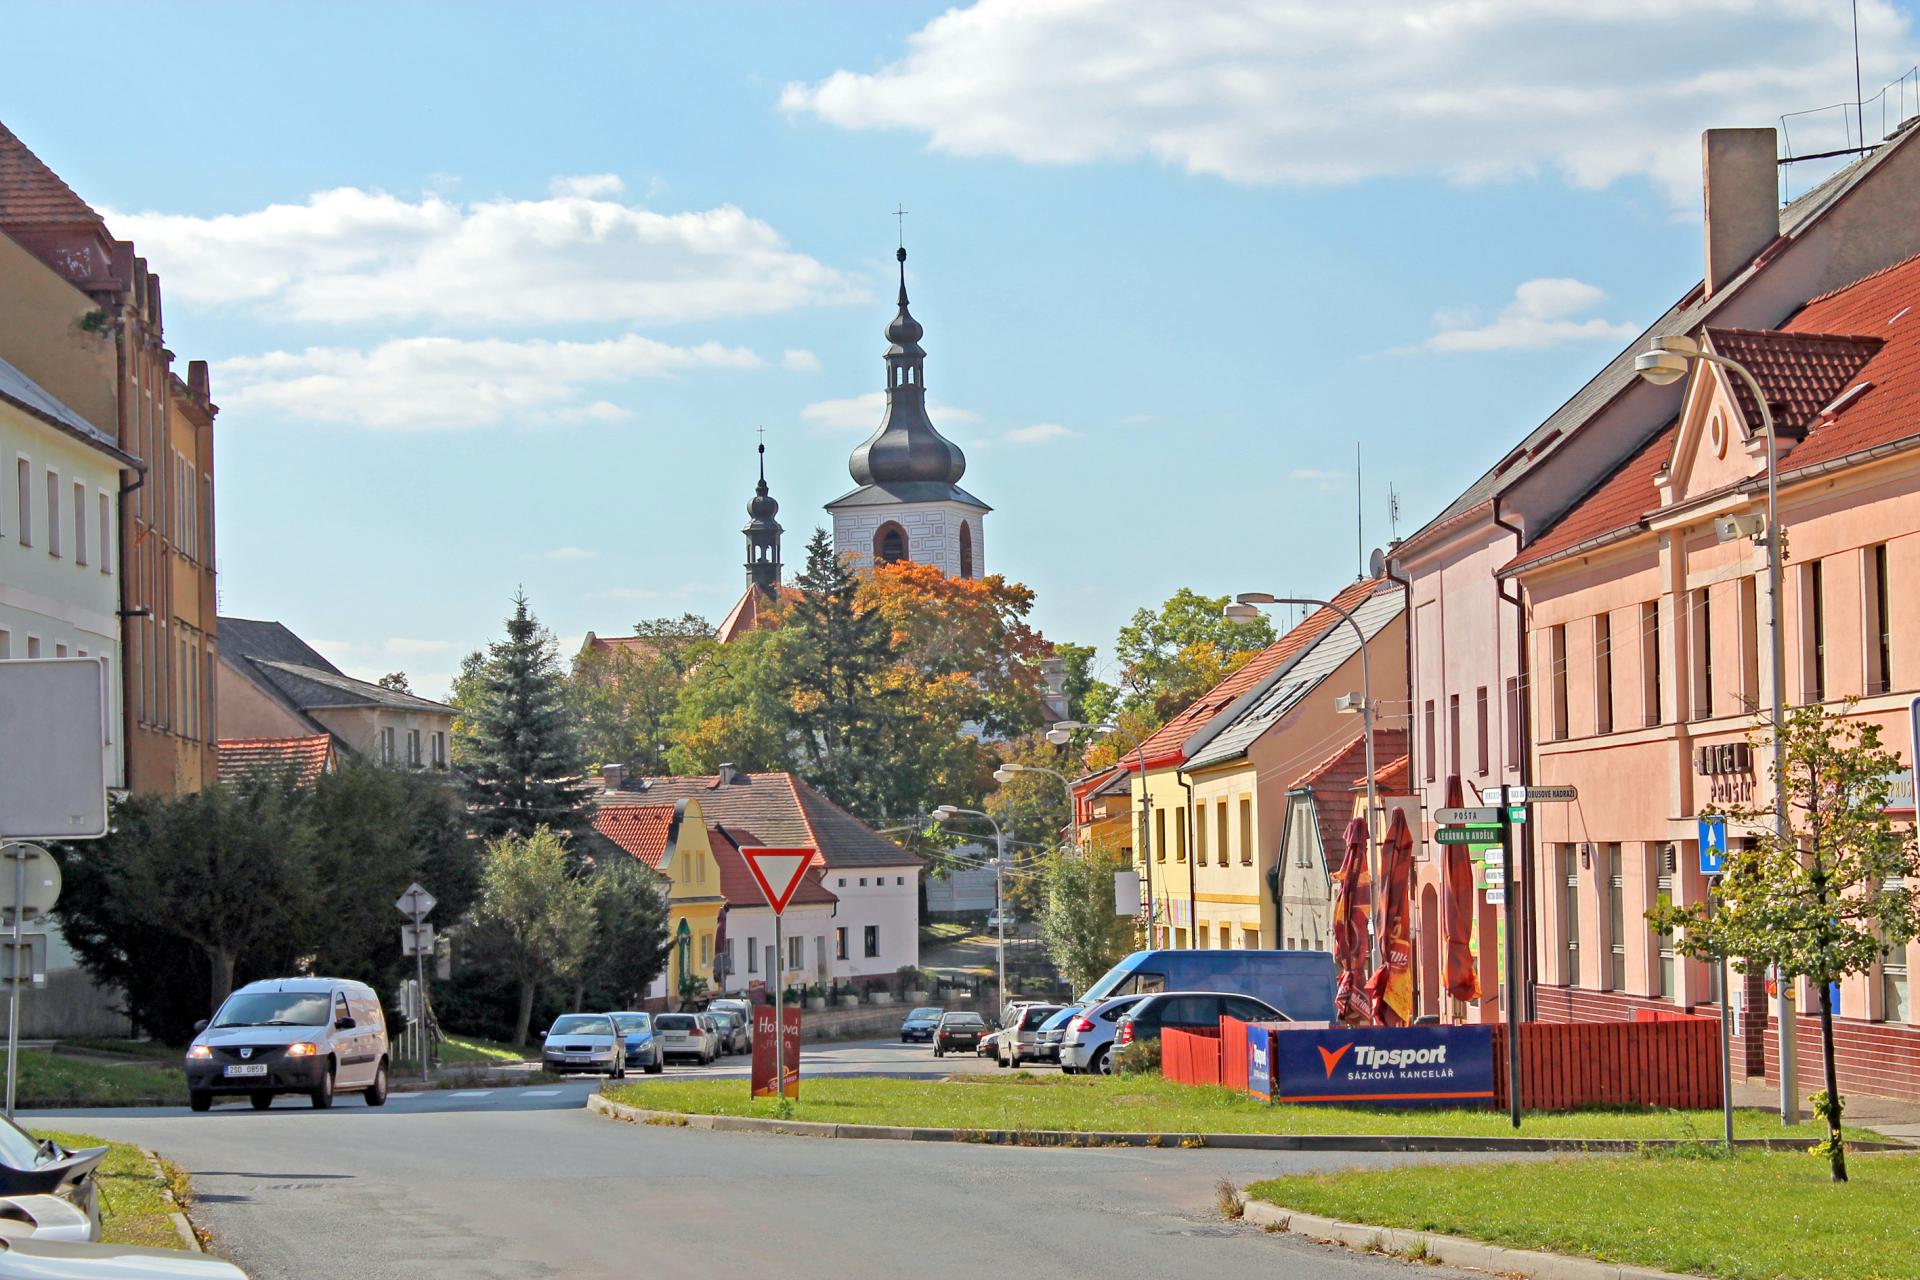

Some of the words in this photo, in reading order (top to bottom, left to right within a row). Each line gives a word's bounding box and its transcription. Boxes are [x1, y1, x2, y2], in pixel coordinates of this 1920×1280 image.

[1454, 810, 1477, 820] POŠTA
[1354, 1045, 1446, 1069] Tipsport
[1347, 1069, 1395, 1080] SÁZKOVÁ
[1400, 1068, 1454, 1079] KANCELÁŘ
